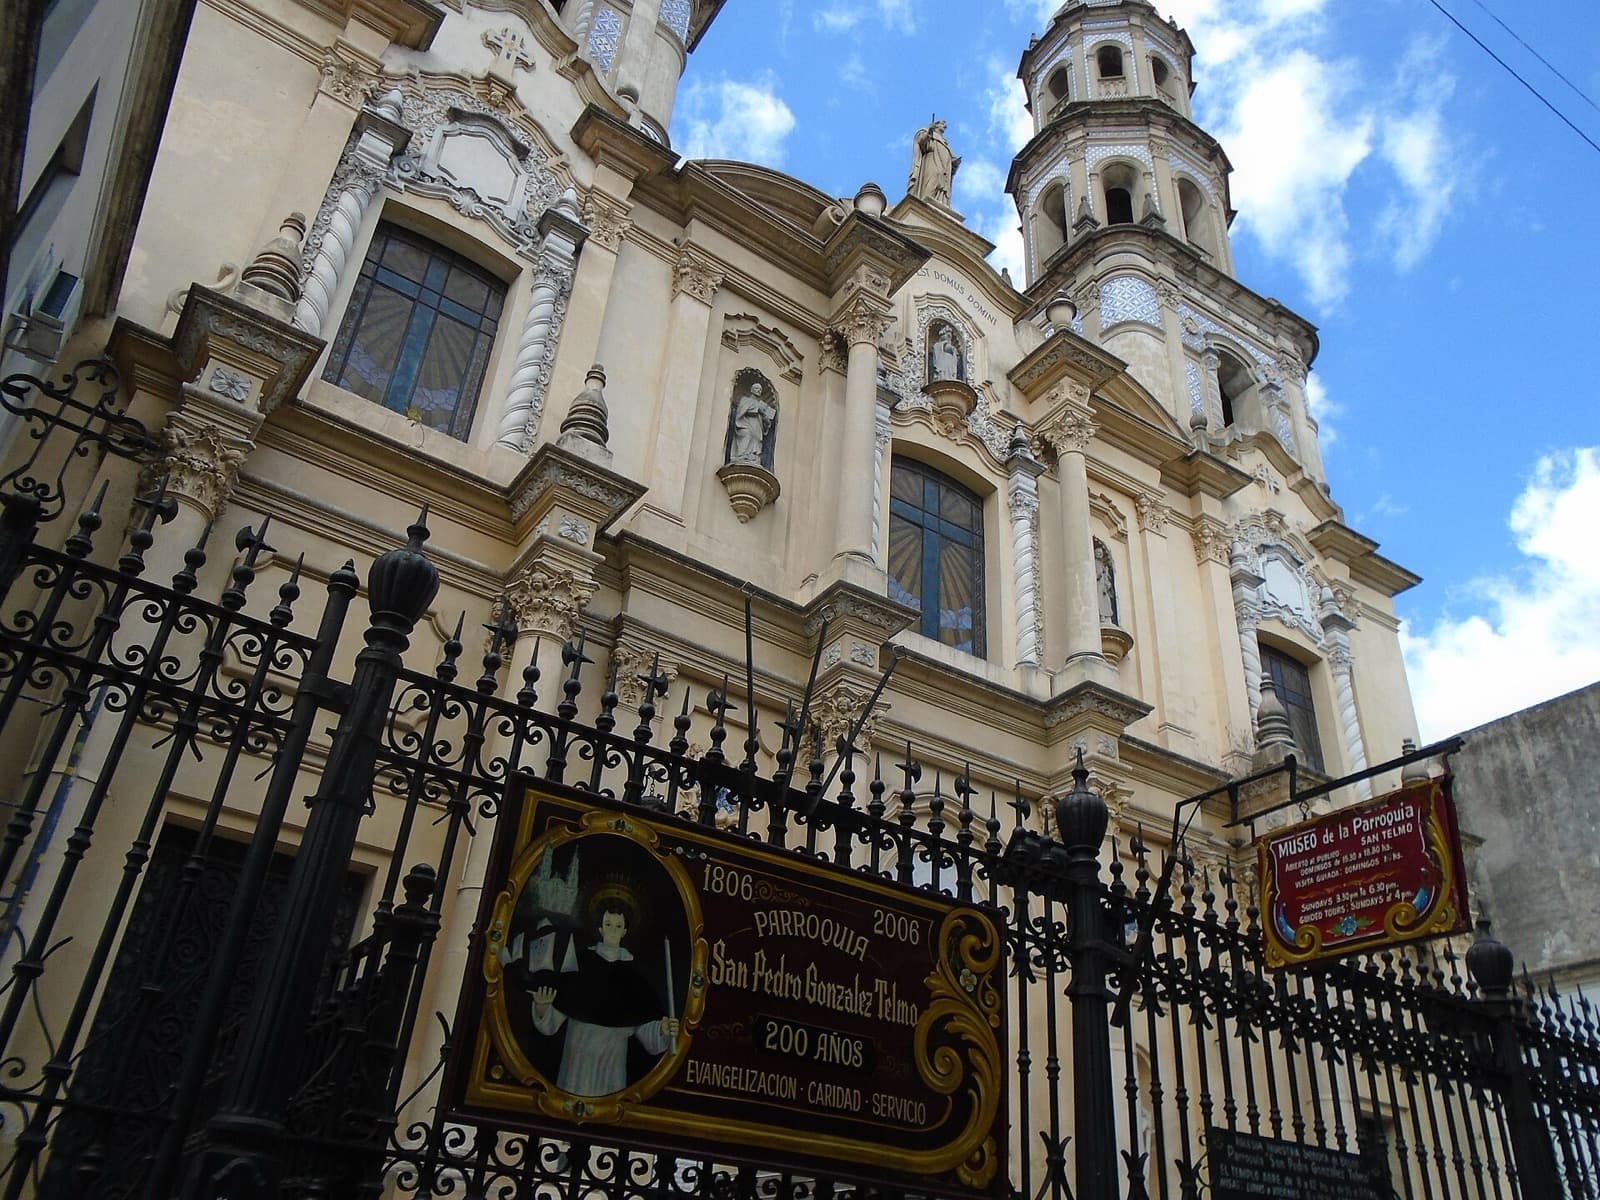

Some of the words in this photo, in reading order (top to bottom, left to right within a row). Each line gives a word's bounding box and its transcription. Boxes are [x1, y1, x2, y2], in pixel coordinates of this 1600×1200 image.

[933, 270, 966, 295] DOMUS
[967, 294, 998, 326] DOMINI
[1278, 832, 1317, 859] MUSEO
[1322, 827, 1335, 845] de
[1338, 823, 1349, 841] la
[1352, 801, 1414, 836] Parroquia
[1360, 833, 1380, 847] SAN
[1382, 822, 1413, 841] TELMO
[702, 863, 754, 902] 1806
[1295, 876, 1314, 889] VISITA
[1344, 857, 1380, 875] DOMINGOS
[1298, 910, 1323, 925] GUIDED
[1350, 895, 1384, 911] SUNDAYS
[1301, 896, 1333, 913] SUNDAYS
[753, 909, 871, 962] PARROQUIA
[872, 909, 920, 945] 2006
[711, 938, 748, 990] San
[751, 948, 803, 1001] Pedro
[804, 961, 873, 1018] Gonzalez
[874, 977, 919, 1028] Telmo
[764, 1021, 809, 1057] 200
[813, 1031, 864, 1068] AÑOS
[685, 1059, 798, 1101] EVANGELIZACION
[807, 1080, 862, 1113] CARIDAD
[872, 1091, 927, 1126] SERVICIO
